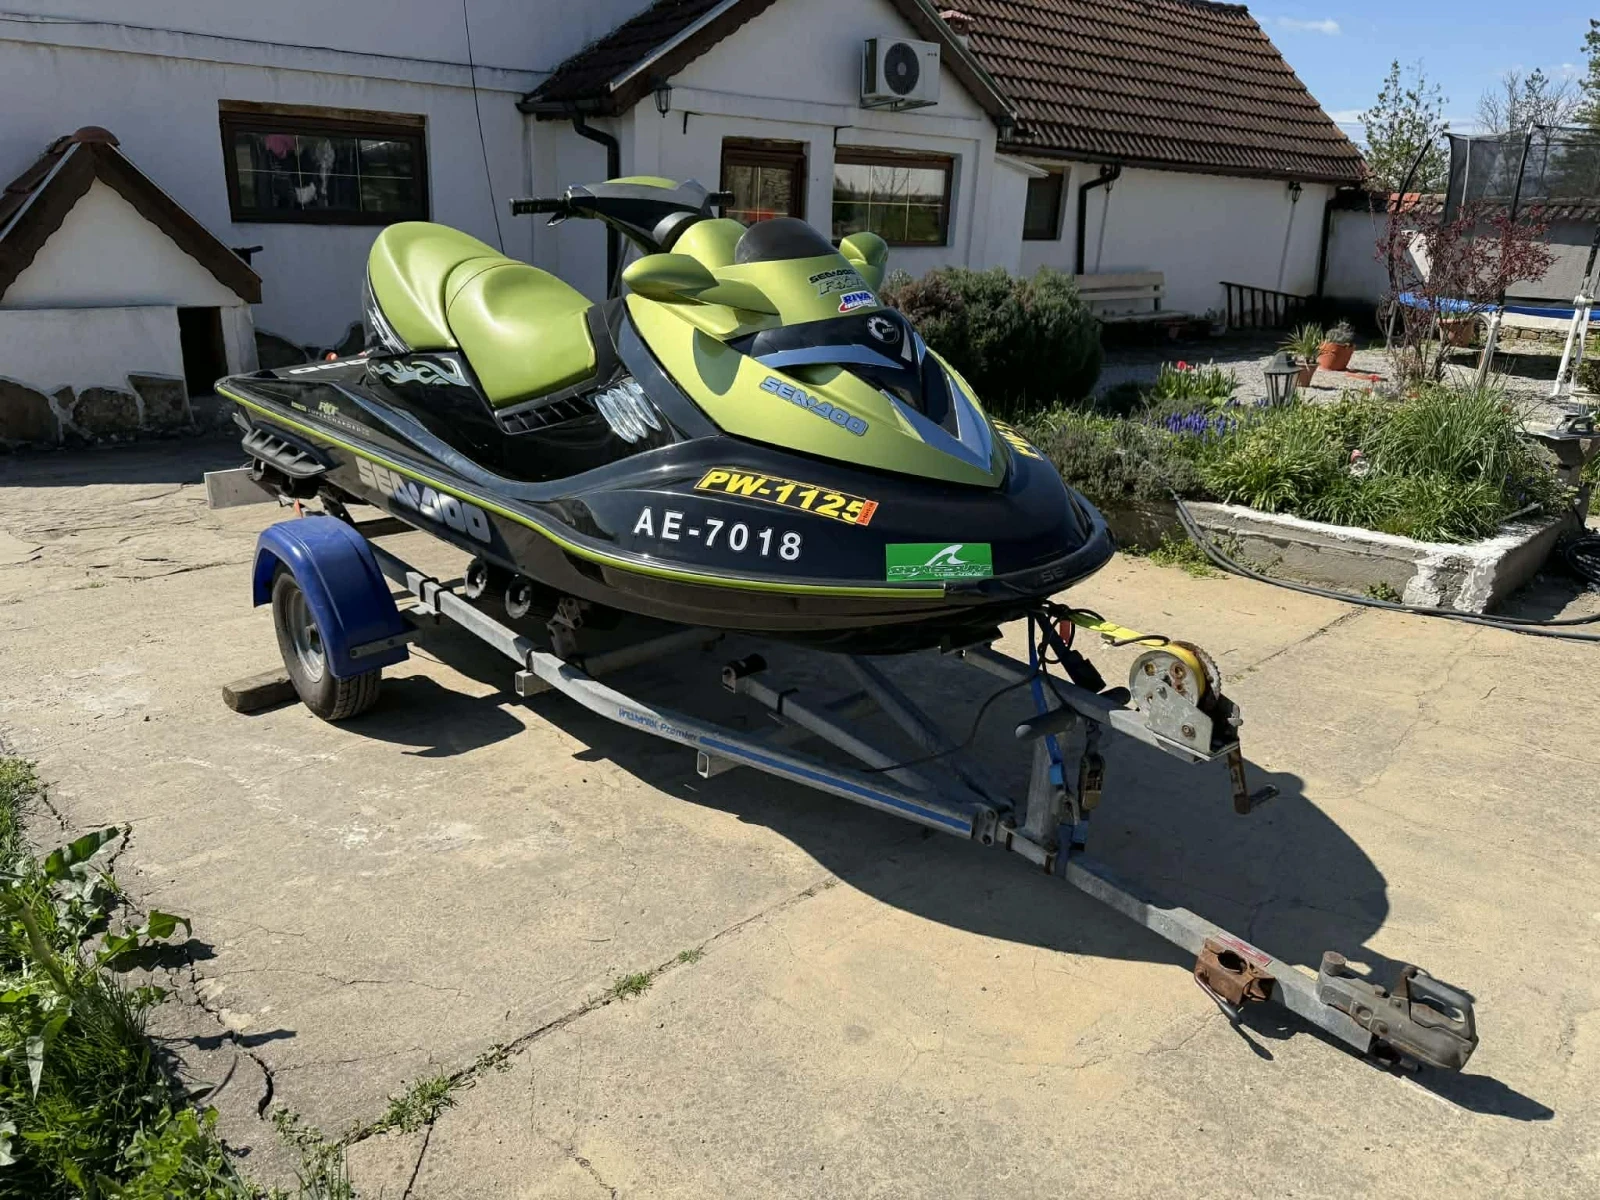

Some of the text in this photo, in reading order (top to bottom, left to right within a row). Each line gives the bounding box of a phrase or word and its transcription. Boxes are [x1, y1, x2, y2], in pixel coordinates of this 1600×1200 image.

[844, 292, 873, 304] RIVA
[699, 471, 865, 523] PW-1125
[633, 507, 801, 561] AE-7018
